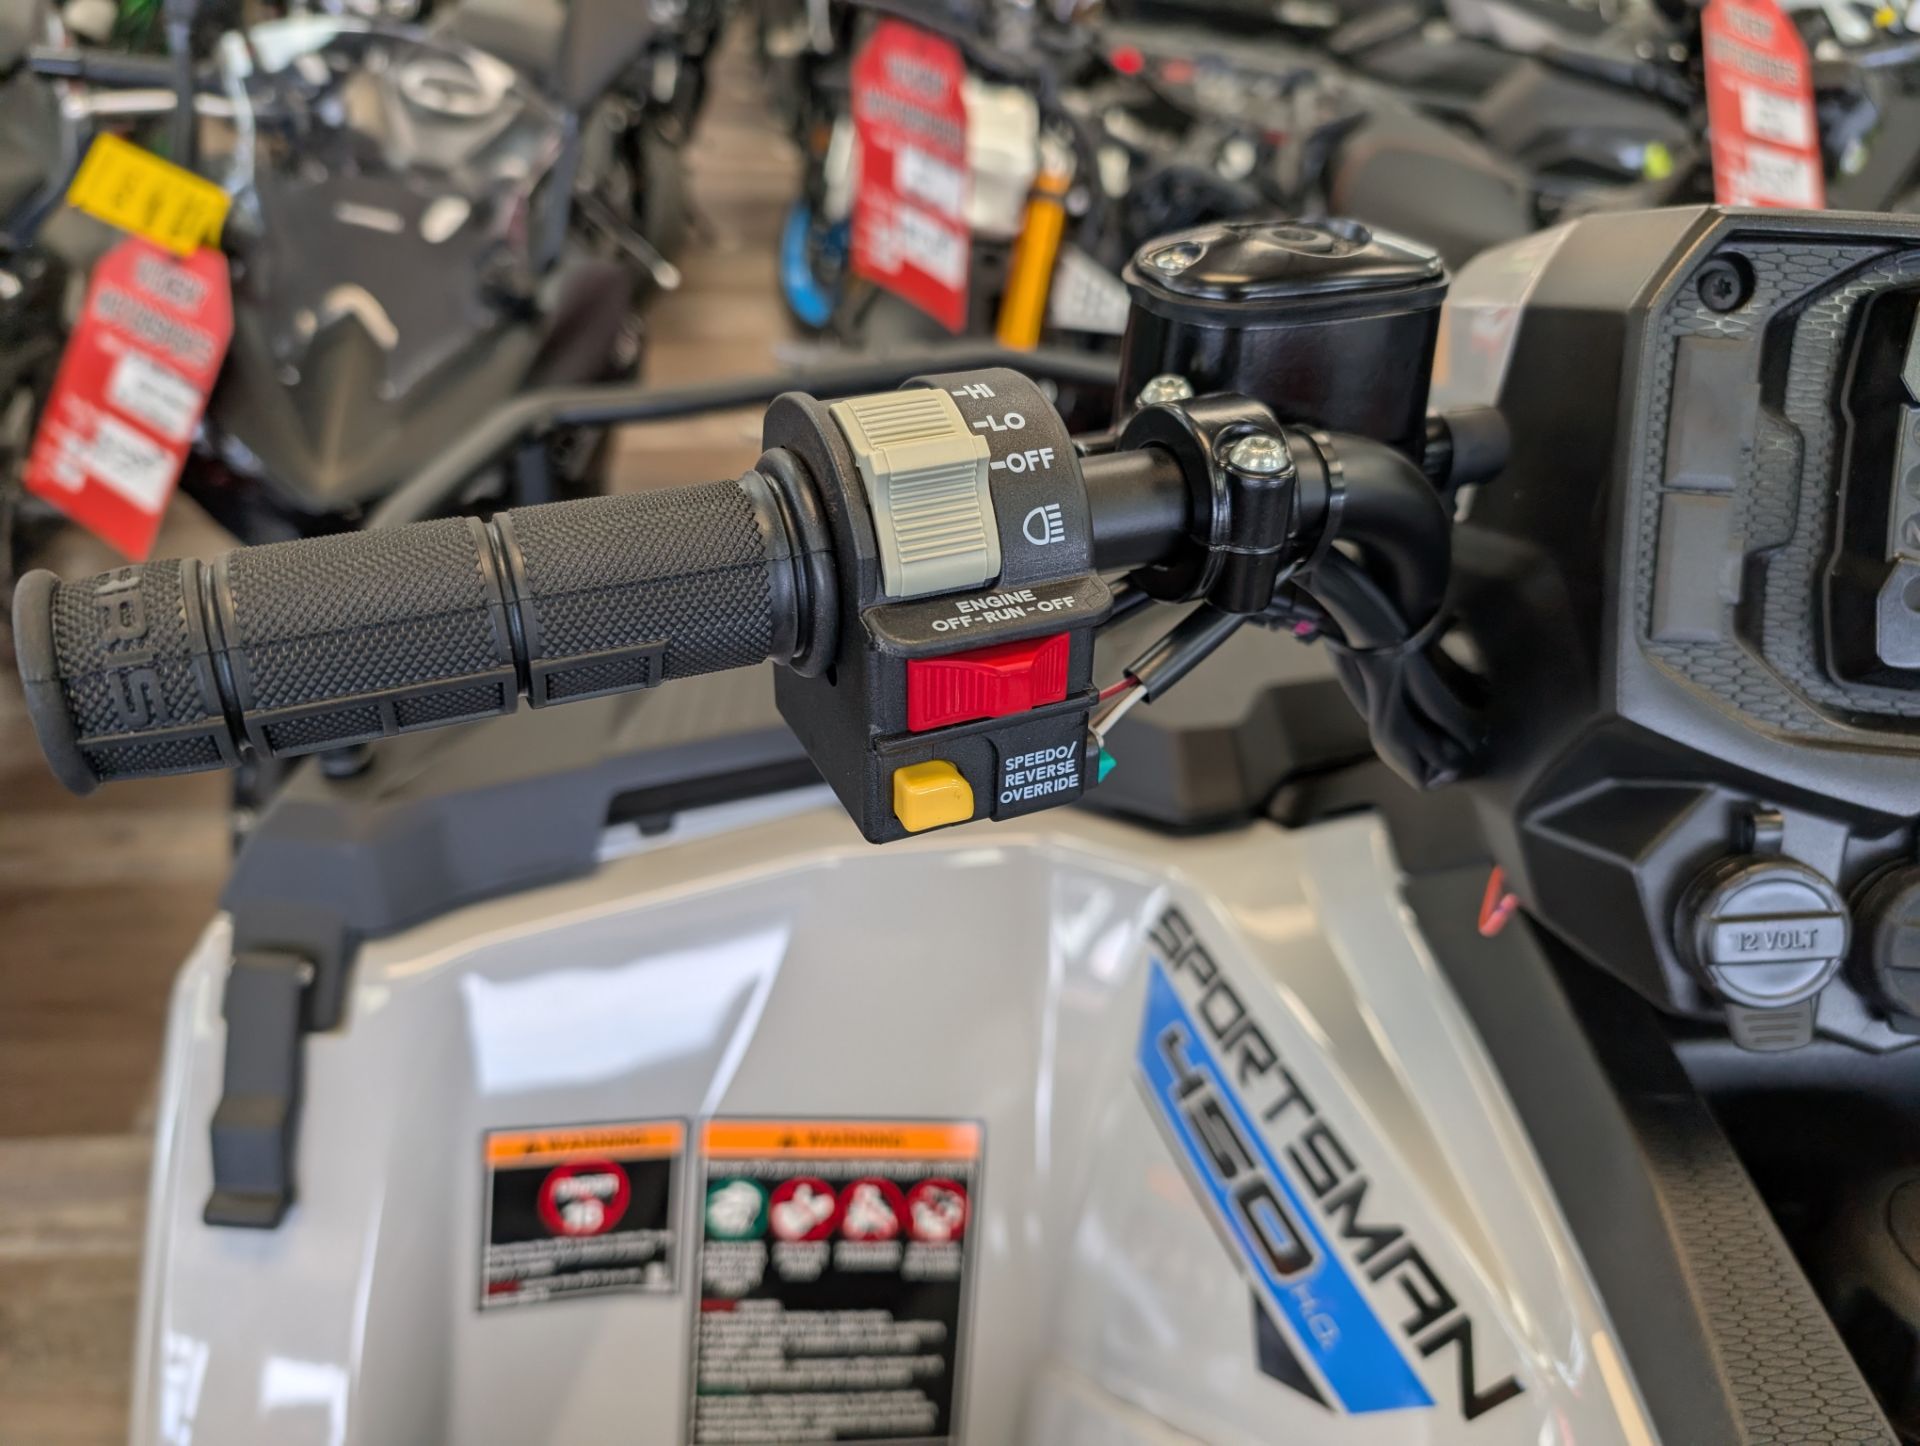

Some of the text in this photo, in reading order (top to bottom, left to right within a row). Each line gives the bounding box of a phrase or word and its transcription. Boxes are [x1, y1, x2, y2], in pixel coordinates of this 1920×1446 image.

[955, 589, 1037, 614] ENGINE
[1004, 740, 1077, 771] SPEEDO/
[999, 774, 1079, 804] OVERRIDE
[1005, 760, 1076, 788] REVERSE
[1737, 929, 1819, 953] 12 VOLT
[1148, 907, 1526, 1421] SPORTSMAN
[1160, 1022, 1319, 1281] 450
